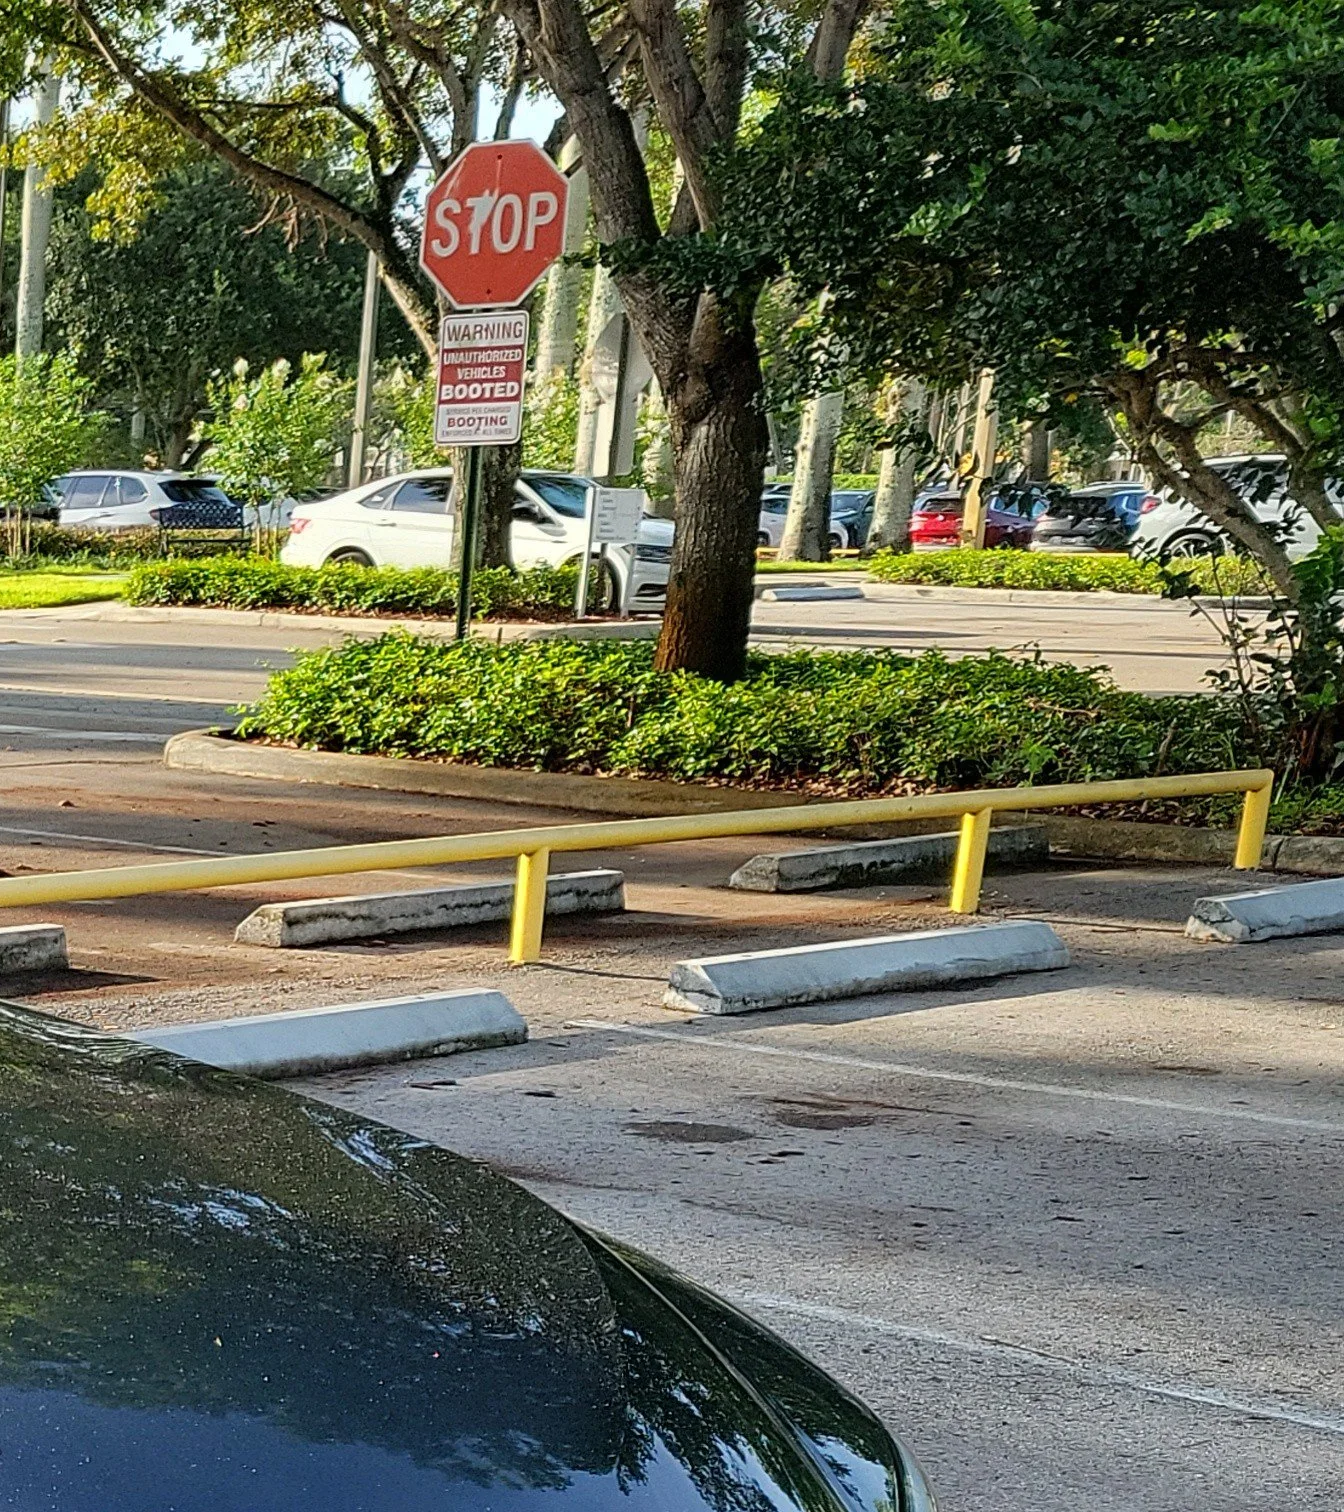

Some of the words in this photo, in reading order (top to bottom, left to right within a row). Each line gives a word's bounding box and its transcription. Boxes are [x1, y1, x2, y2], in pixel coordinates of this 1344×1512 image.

[431, 191, 558, 258] STOP
[446, 321, 523, 341] WARNING
[443, 348, 522, 365] UNAUTHORIZED
[456, 365, 506, 380] VEHICLES
[440, 381, 520, 400] BOOTED
[447, 415, 508, 428] BOOTING
